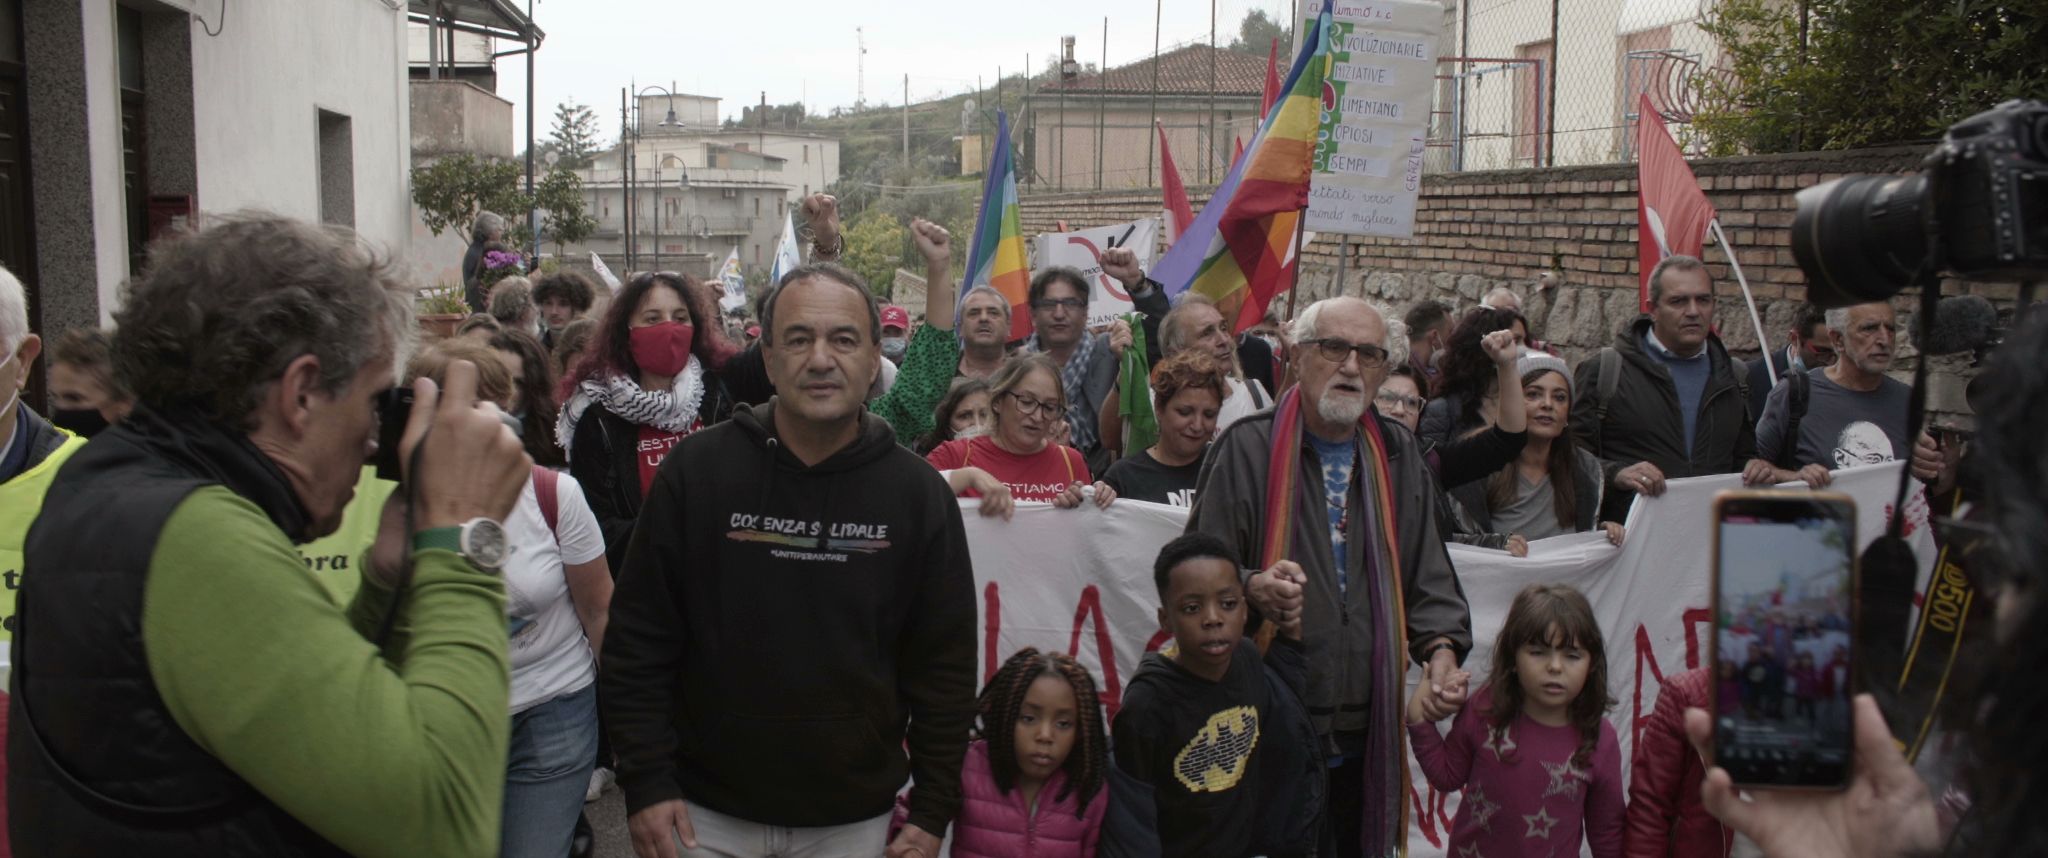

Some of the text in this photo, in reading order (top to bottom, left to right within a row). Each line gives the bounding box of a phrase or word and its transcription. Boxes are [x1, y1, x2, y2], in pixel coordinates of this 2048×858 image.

[1341, 98, 1399, 118] LIMENTANO
[1335, 125, 1373, 144] OPIOSI
[1330, 155, 1367, 173] SEMPI
[1310, 184, 1355, 202] ettati
[1086, 312, 1121, 326] CIANO
[1001, 481, 1065, 494] STIAMO
[810, 520, 889, 539] SLIDALE
[1929, 562, 1969, 633] D500
